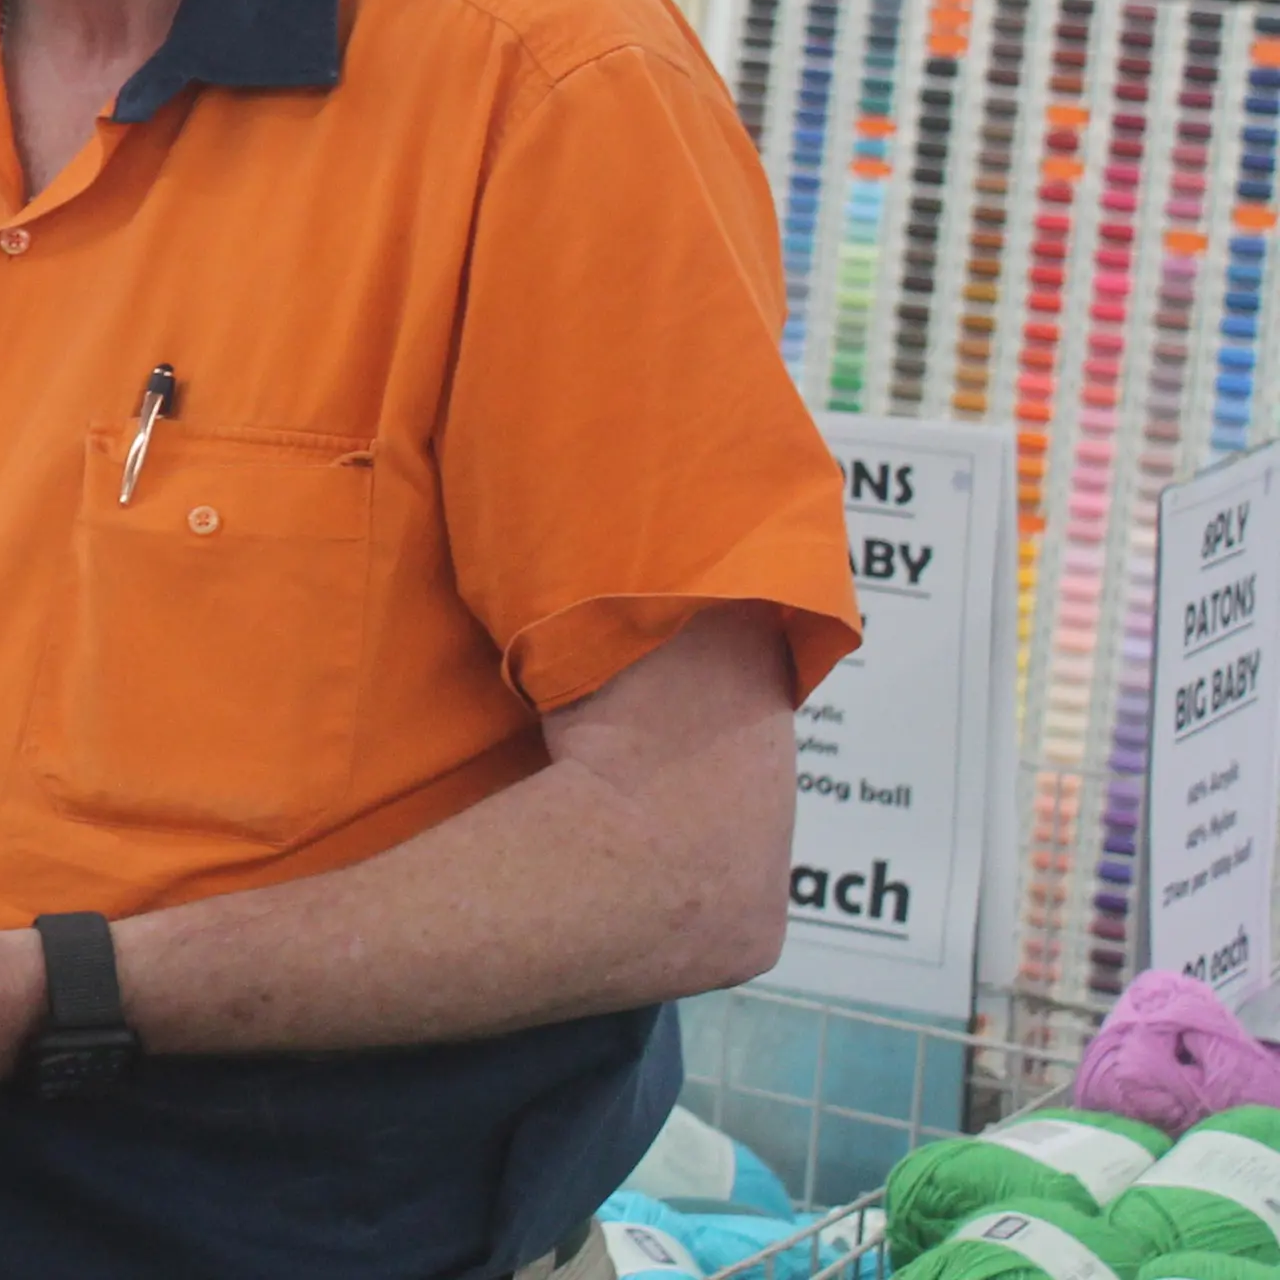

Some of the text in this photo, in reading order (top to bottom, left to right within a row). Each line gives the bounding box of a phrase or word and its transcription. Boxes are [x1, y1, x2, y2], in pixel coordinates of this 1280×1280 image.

[841, 458, 915, 506] NS
[1183, 572, 1257, 648] PATONS
[1174, 646, 1261, 734] BIG BABY
[796, 772, 913, 809] 00g ball
[791, 858, 911, 923] ach
